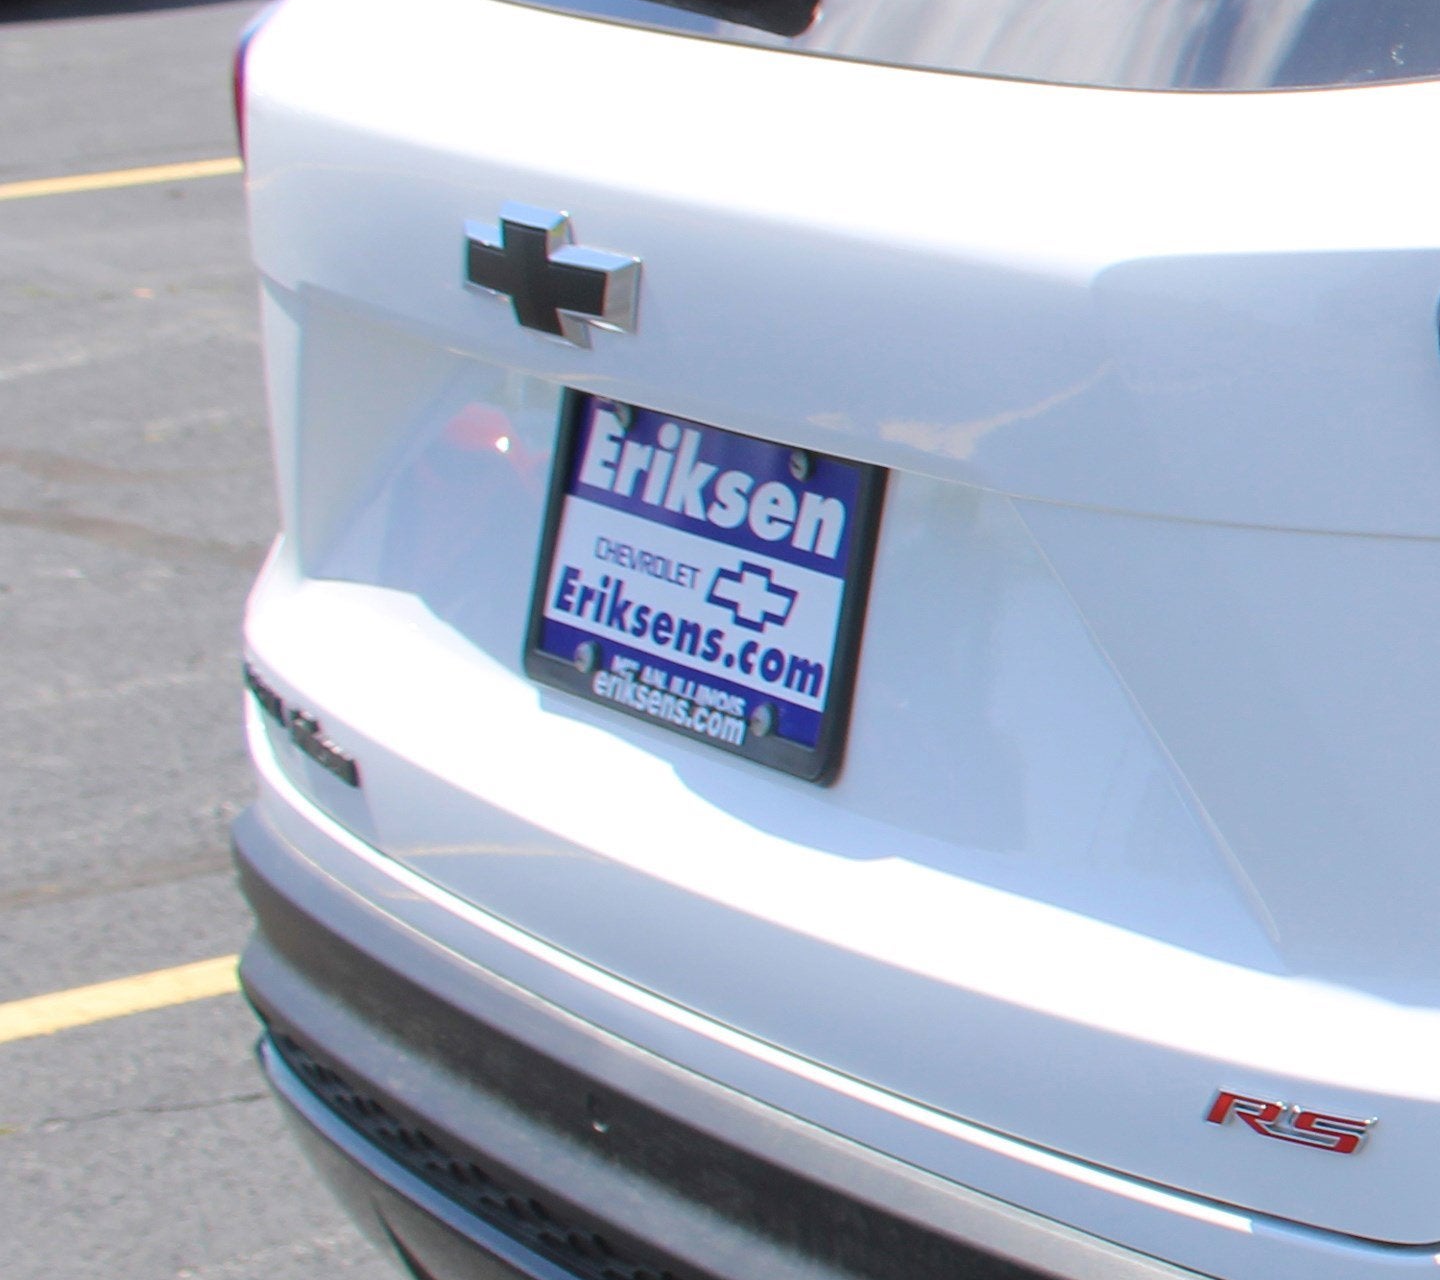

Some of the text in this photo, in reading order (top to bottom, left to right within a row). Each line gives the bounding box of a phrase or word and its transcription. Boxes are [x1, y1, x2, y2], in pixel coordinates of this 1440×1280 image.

[577, 408, 847, 559] Eriksen
[594, 535, 700, 590] CHEVROLET
[555, 565, 825, 698] Eriksens.com
[1204, 1087, 1378, 1155] RS
